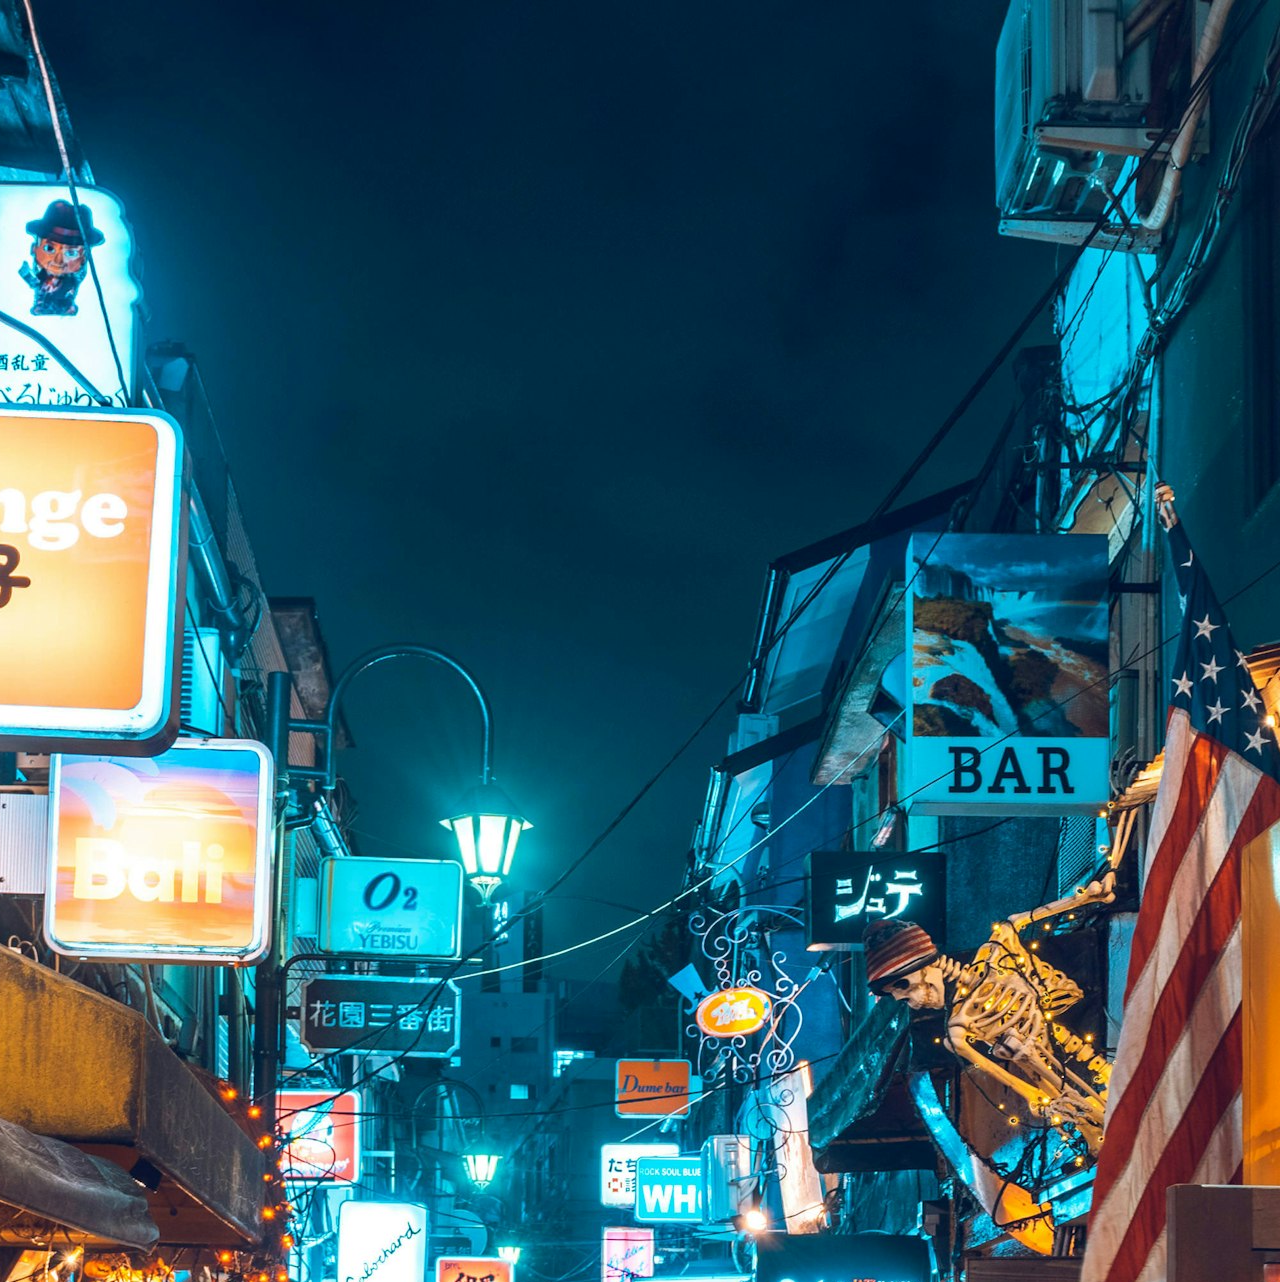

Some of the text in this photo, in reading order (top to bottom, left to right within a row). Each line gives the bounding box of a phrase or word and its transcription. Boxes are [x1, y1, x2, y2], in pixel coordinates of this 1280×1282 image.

[949, 746, 1075, 794] BAR
[73, 838, 225, 904] Bali
[834, 865, 923, 921] ジュテ
[358, 933, 419, 951] YEBISU
[310, 1000, 454, 1033] 花園三番街
[665, 1078, 687, 1094] bar
[640, 1168, 660, 1176] ROCK
[662, 1167, 681, 1176] SOUL
